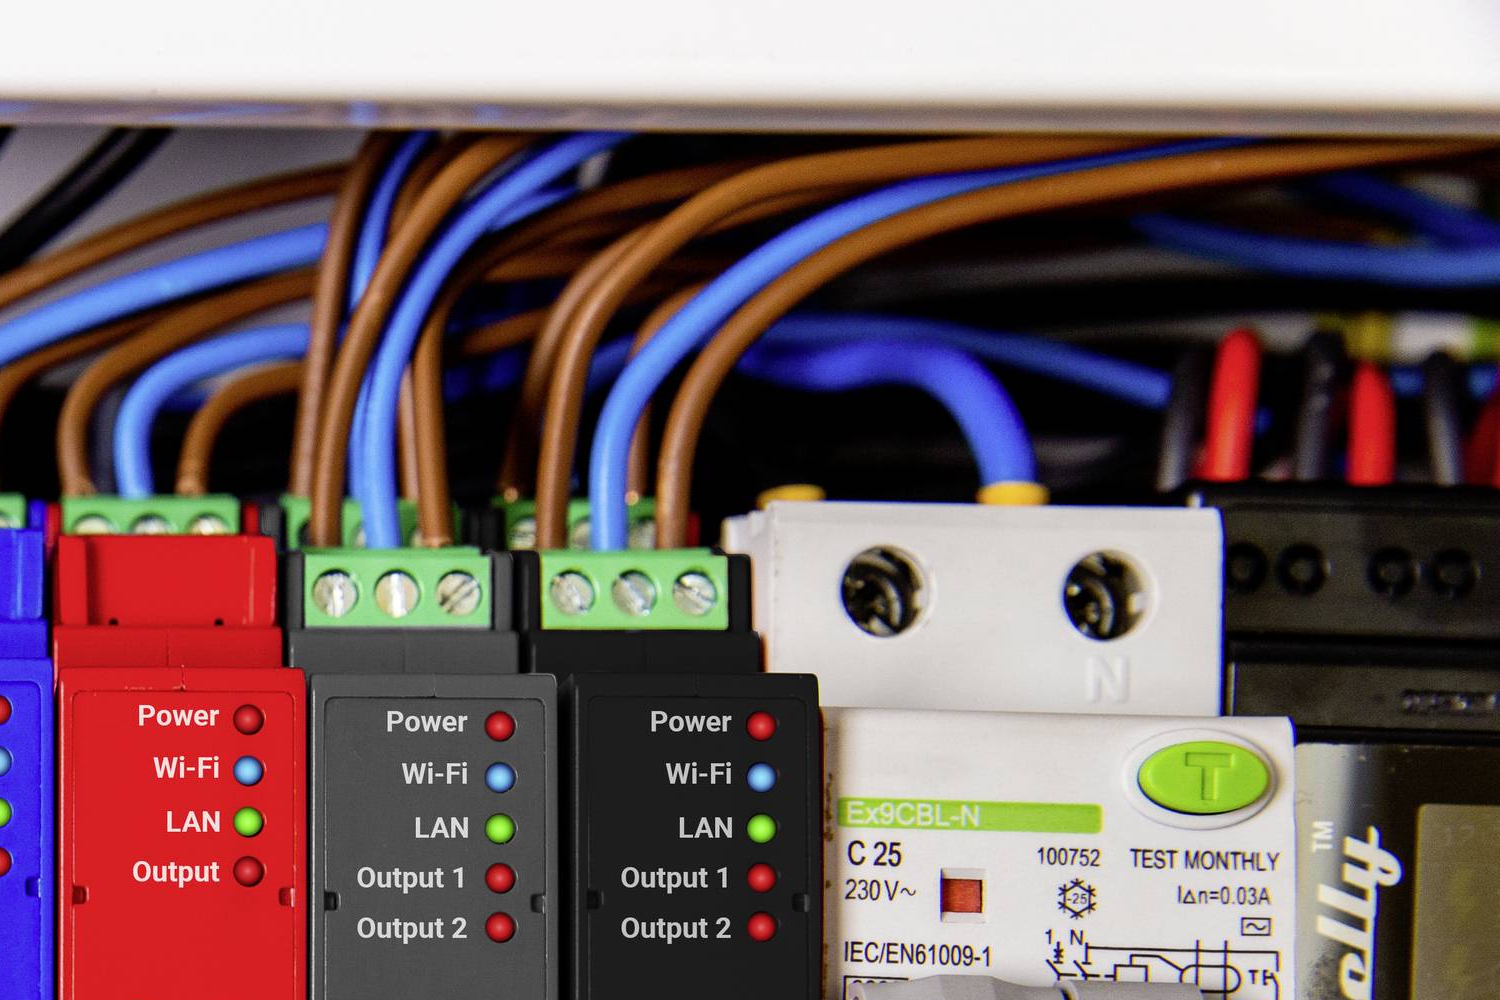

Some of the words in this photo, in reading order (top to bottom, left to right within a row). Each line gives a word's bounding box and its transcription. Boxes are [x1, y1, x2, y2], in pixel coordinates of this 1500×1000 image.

[1087, 658, 1131, 701] N
[139, 705, 219, 726] Power
[387, 711, 467, 732] Power
[652, 711, 731, 732] Power
[154, 756, 219, 778] Wi-Fi
[402, 762, 467, 784] Wi-Fi
[666, 762, 731, 784] Wi-Fi
[1185, 752, 1235, 800] T
[167, 811, 220, 832] LAN
[845, 801, 981, 827] Ex9CBL-N
[416, 817, 468, 838] LAN
[680, 817, 732, 838] LAN
[1312, 821, 1334, 852] TM
[848, 840, 865, 865] C
[874, 842, 901, 867] 25
[1038, 847, 1100, 867] 100752
[1130, 848, 1178, 869] TEST
[1185, 850, 1279, 871] MONTHLY
[133, 861, 219, 888] Output
[357, 867, 444, 894] Output
[453, 867, 463, 888] 1
[621, 867, 708, 894] Output
[717, 867, 727, 888] 1
[357, 917, 444, 944] Output
[452, 917, 467, 938] 2
[621, 917, 708, 944] Output
[716, 917, 731, 938] 2
[1045, 929, 1052, 944] 1
[1070, 930, 1084, 945] N
[843, 941, 991, 967] IEC/EN61009-1
